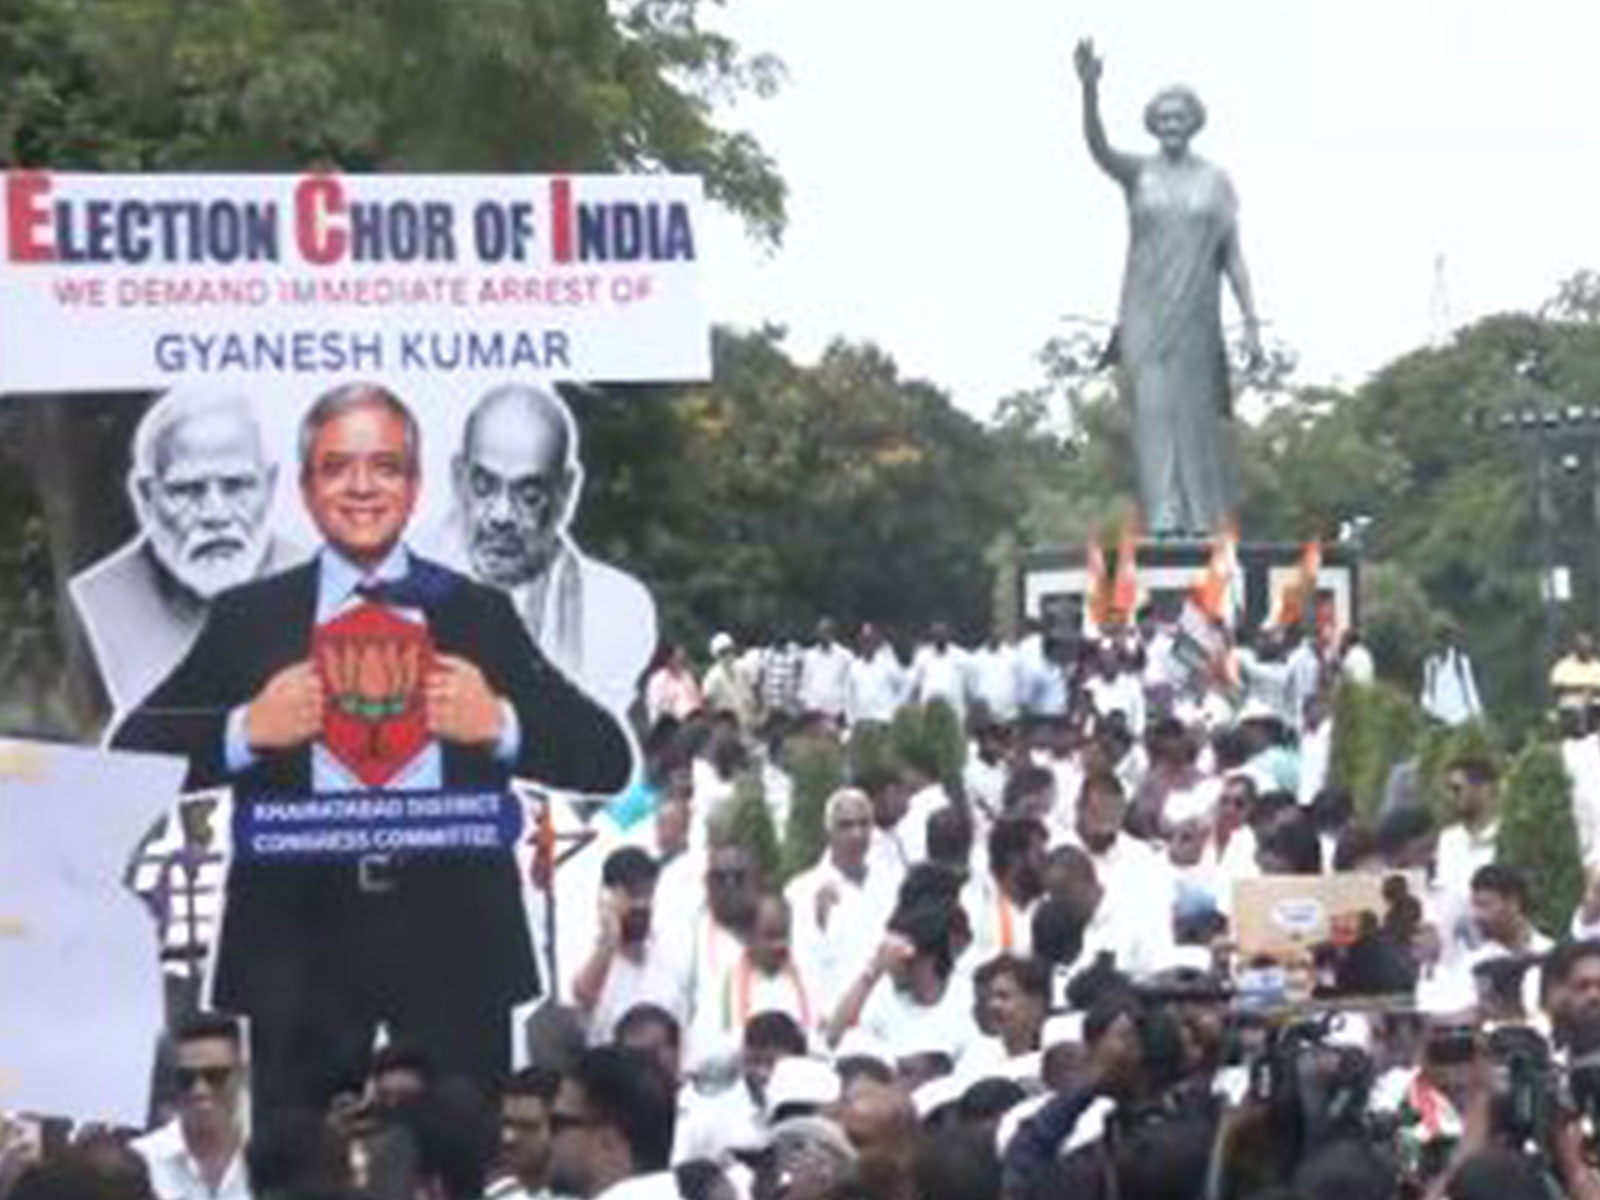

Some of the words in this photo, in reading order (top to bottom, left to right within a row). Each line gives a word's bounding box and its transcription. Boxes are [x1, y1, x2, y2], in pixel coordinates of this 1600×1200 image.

[6, 171, 279, 264] ELECTION
[294, 174, 456, 264] CHOR
[474, 201, 533, 262] OF
[551, 178, 696, 263] INDIA
[54, 279, 105, 308] WE
[117, 277, 267, 308] DEMAND
[279, 277, 468, 307] IMMEDIATE
[478, 275, 600, 304] ARREST
[610, 275, 653, 302] OF
[154, 332, 381, 373] GYANESH
[400, 329, 572, 370] KUMAR
